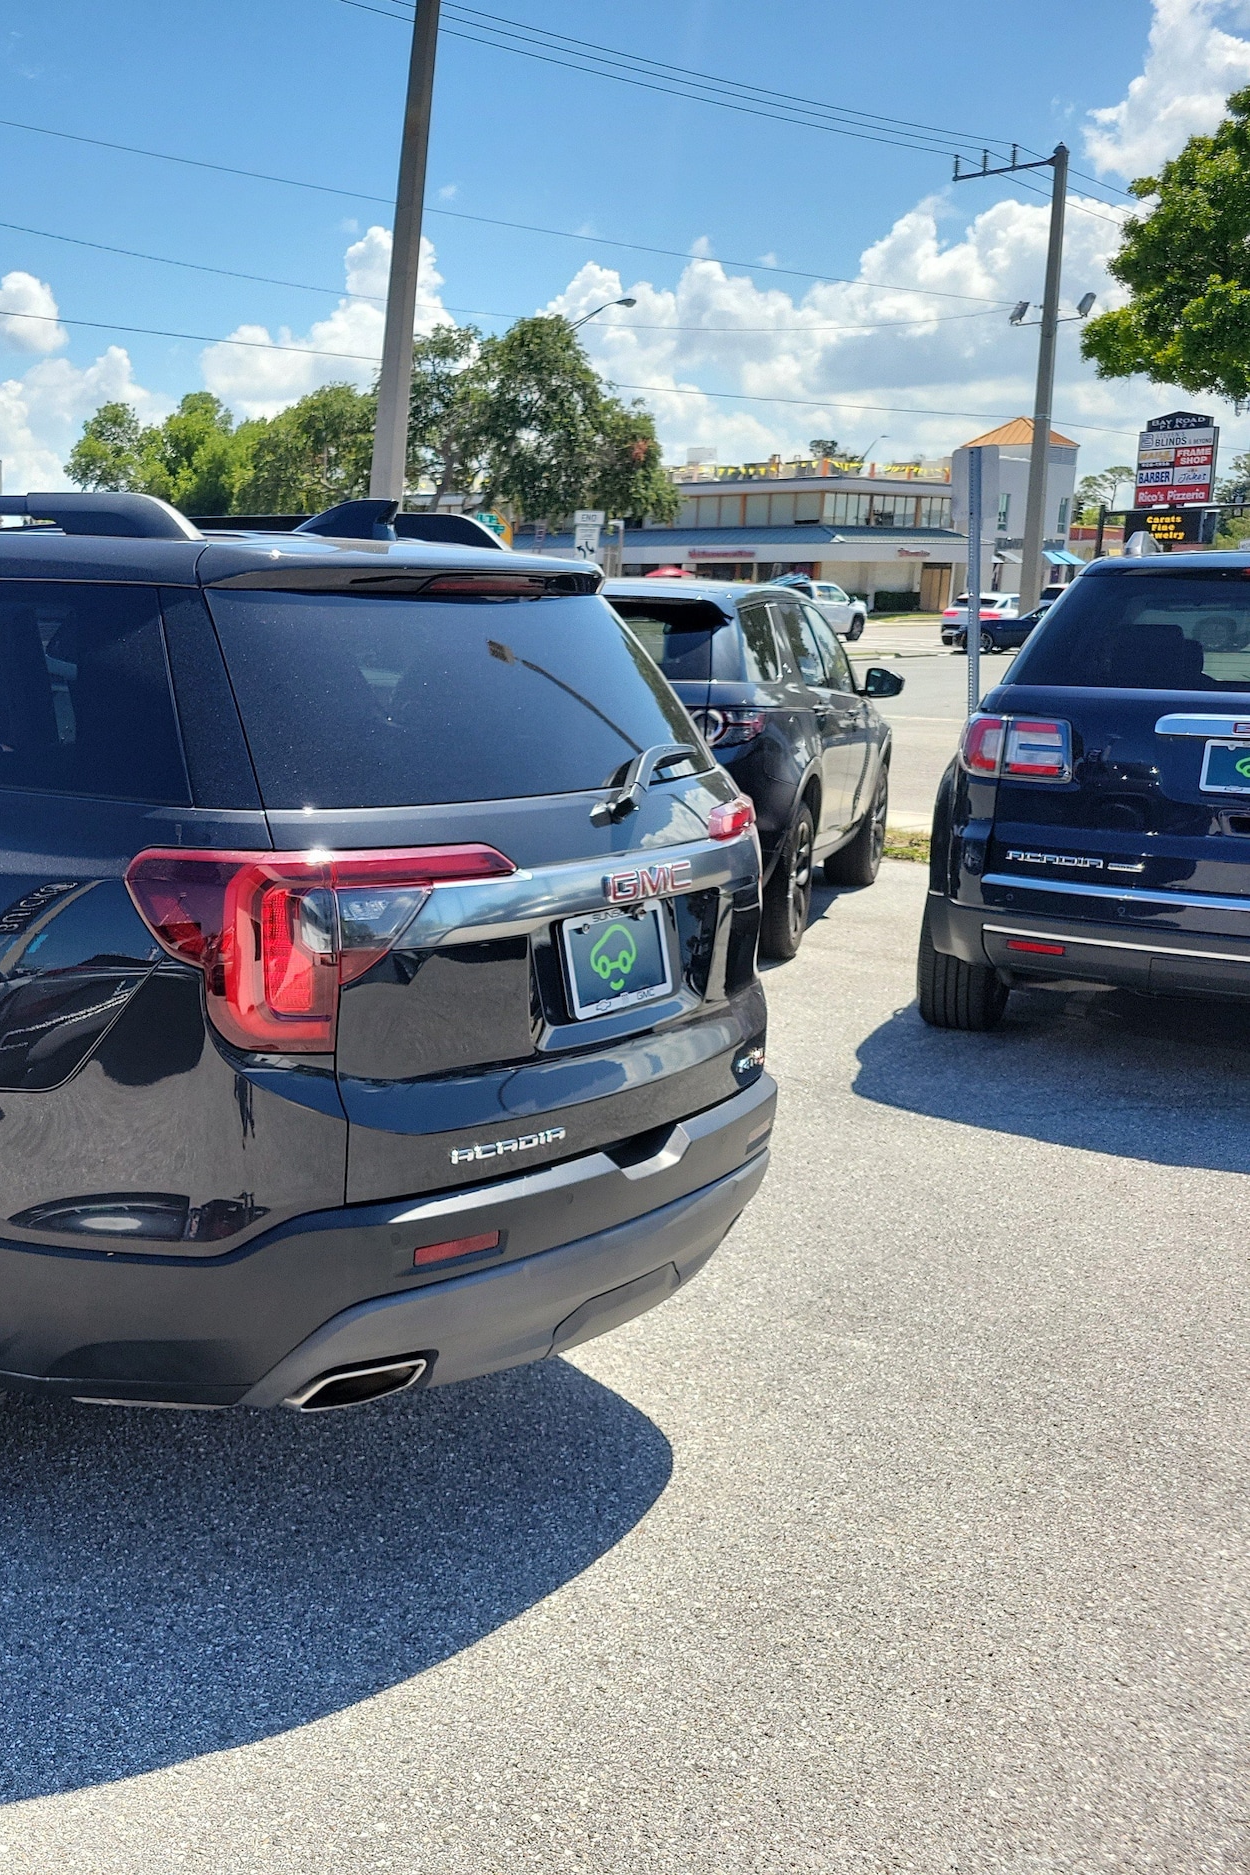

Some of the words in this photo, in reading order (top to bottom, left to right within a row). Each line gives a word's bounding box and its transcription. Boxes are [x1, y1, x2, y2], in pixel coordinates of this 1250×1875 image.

[1151, 419, 1174, 427] BAY
[1175, 416, 1206, 424] ROAD
[1154, 437, 1187, 447] BLINDS
[1176, 447, 1212, 457] FRAME
[1179, 456, 1208, 465] SHOP
[1138, 471, 1170, 484] BARBER
[1138, 491, 1165, 502] Rico's
[1166, 488, 1206, 501] Pizzeria
[1146, 516, 1183, 524] Carats
[1150, 531, 1186, 541] welry
[1005, 850, 1104, 869] ACADIA
[603, 860, 692, 903] GMC
[636, 988, 655, 1000] GMC
[450, 1127, 566, 1165] ACADIA
